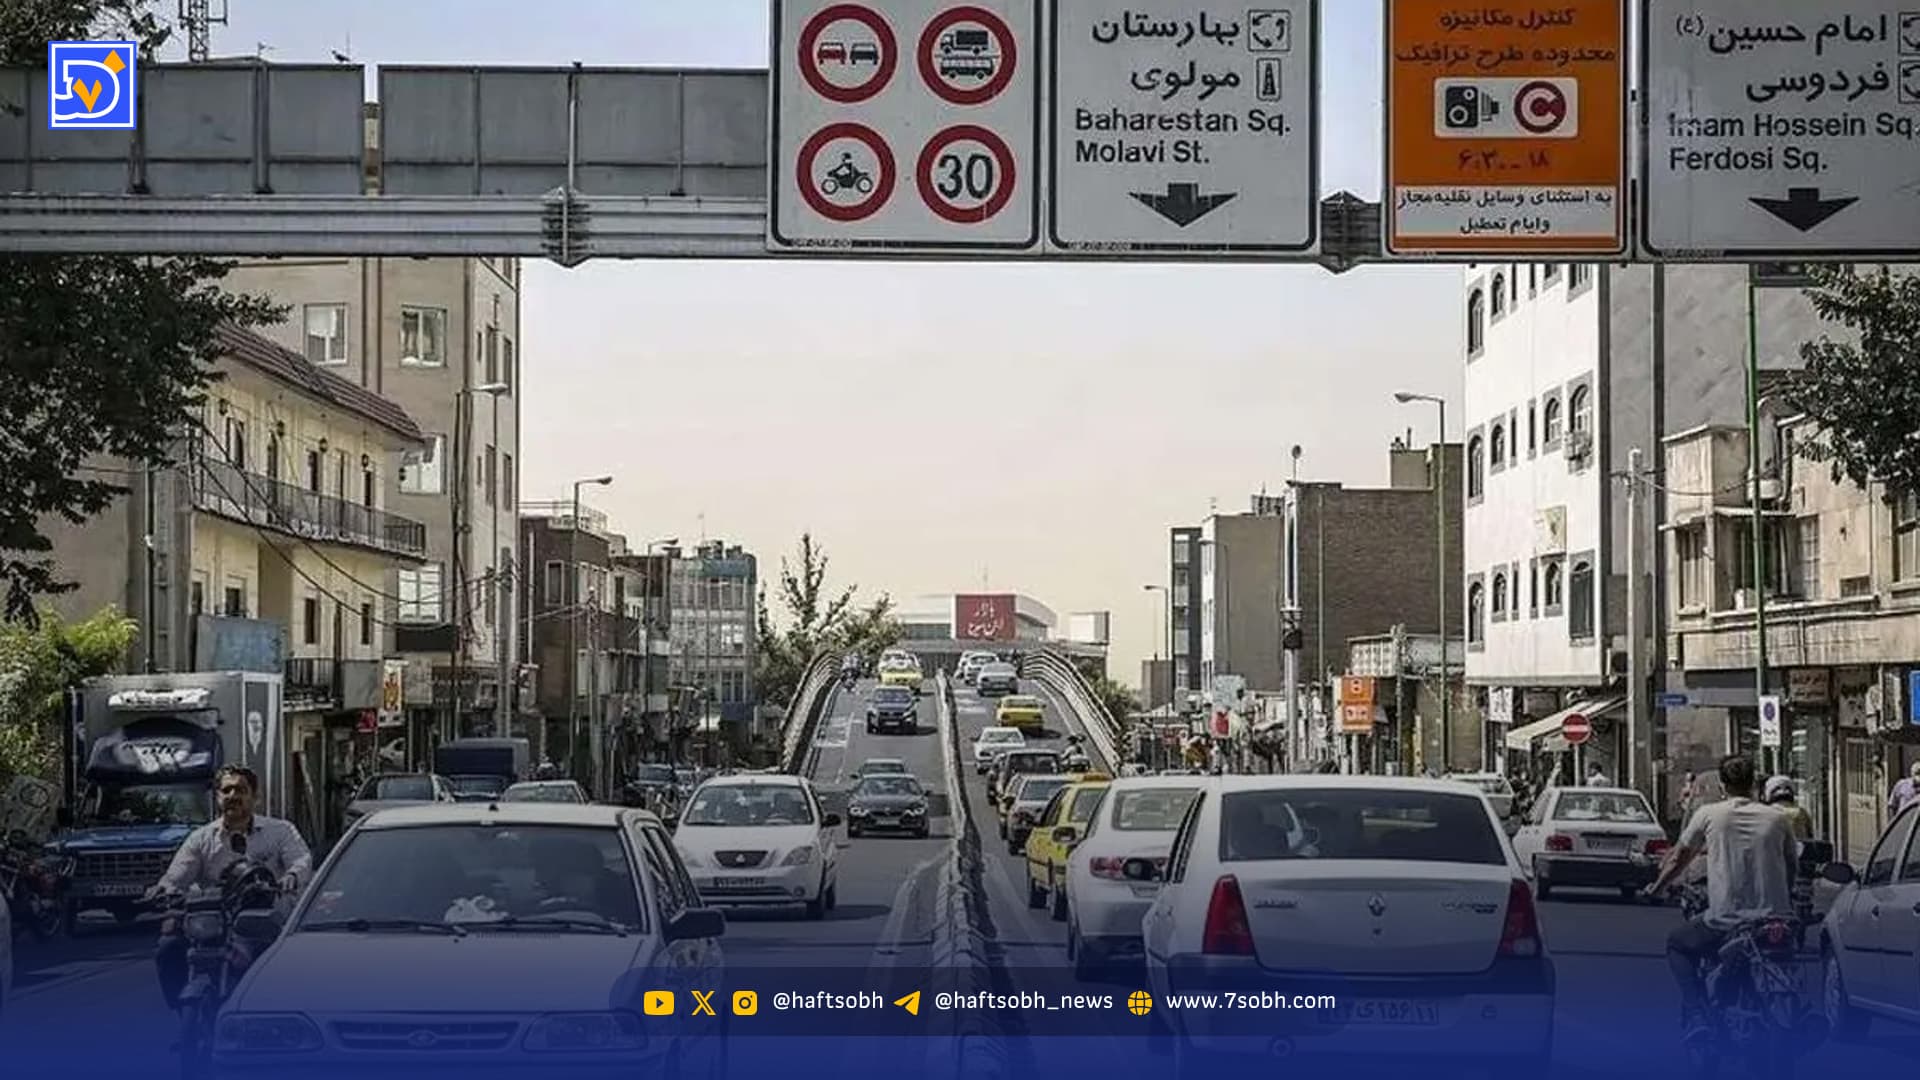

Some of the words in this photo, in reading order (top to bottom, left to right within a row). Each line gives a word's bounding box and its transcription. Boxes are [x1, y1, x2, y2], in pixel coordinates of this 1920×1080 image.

[1092, 11, 1240, 48] بهارستان
[1439, 9, 1514, 31] مکانیزه
[1518, 8, 1576, 30] کنترل
[1709, 24, 1806, 54] حسین
[1815, 14, 1887, 55] امام
[1395, 43, 1469, 66] ترافیک
[1475, 45, 1524, 68] طرح
[1532, 48, 1616, 66] محدوده
[1130, 61, 1241, 100] مولوی
[1746, 62, 1890, 102] فردوسی
[1076, 108, 1238, 132] Baharestan
[1248, 109, 1291, 136] Sq.
[1754, 112, 1866, 136] Hossein
[1076, 140, 1165, 163] Molavi
[1173, 140, 1210, 163] St.
[1670, 147, 1773, 170] Ferdosi
[1783, 147, 1828, 173] Sq.
[938, 154, 993, 199] 30
[1476, 190, 1525, 207] وسایل
[1530, 190, 1590, 206] استثنای
[1592, 192, 1613, 207] به
[1459, 217, 1507, 234] تعطیل
